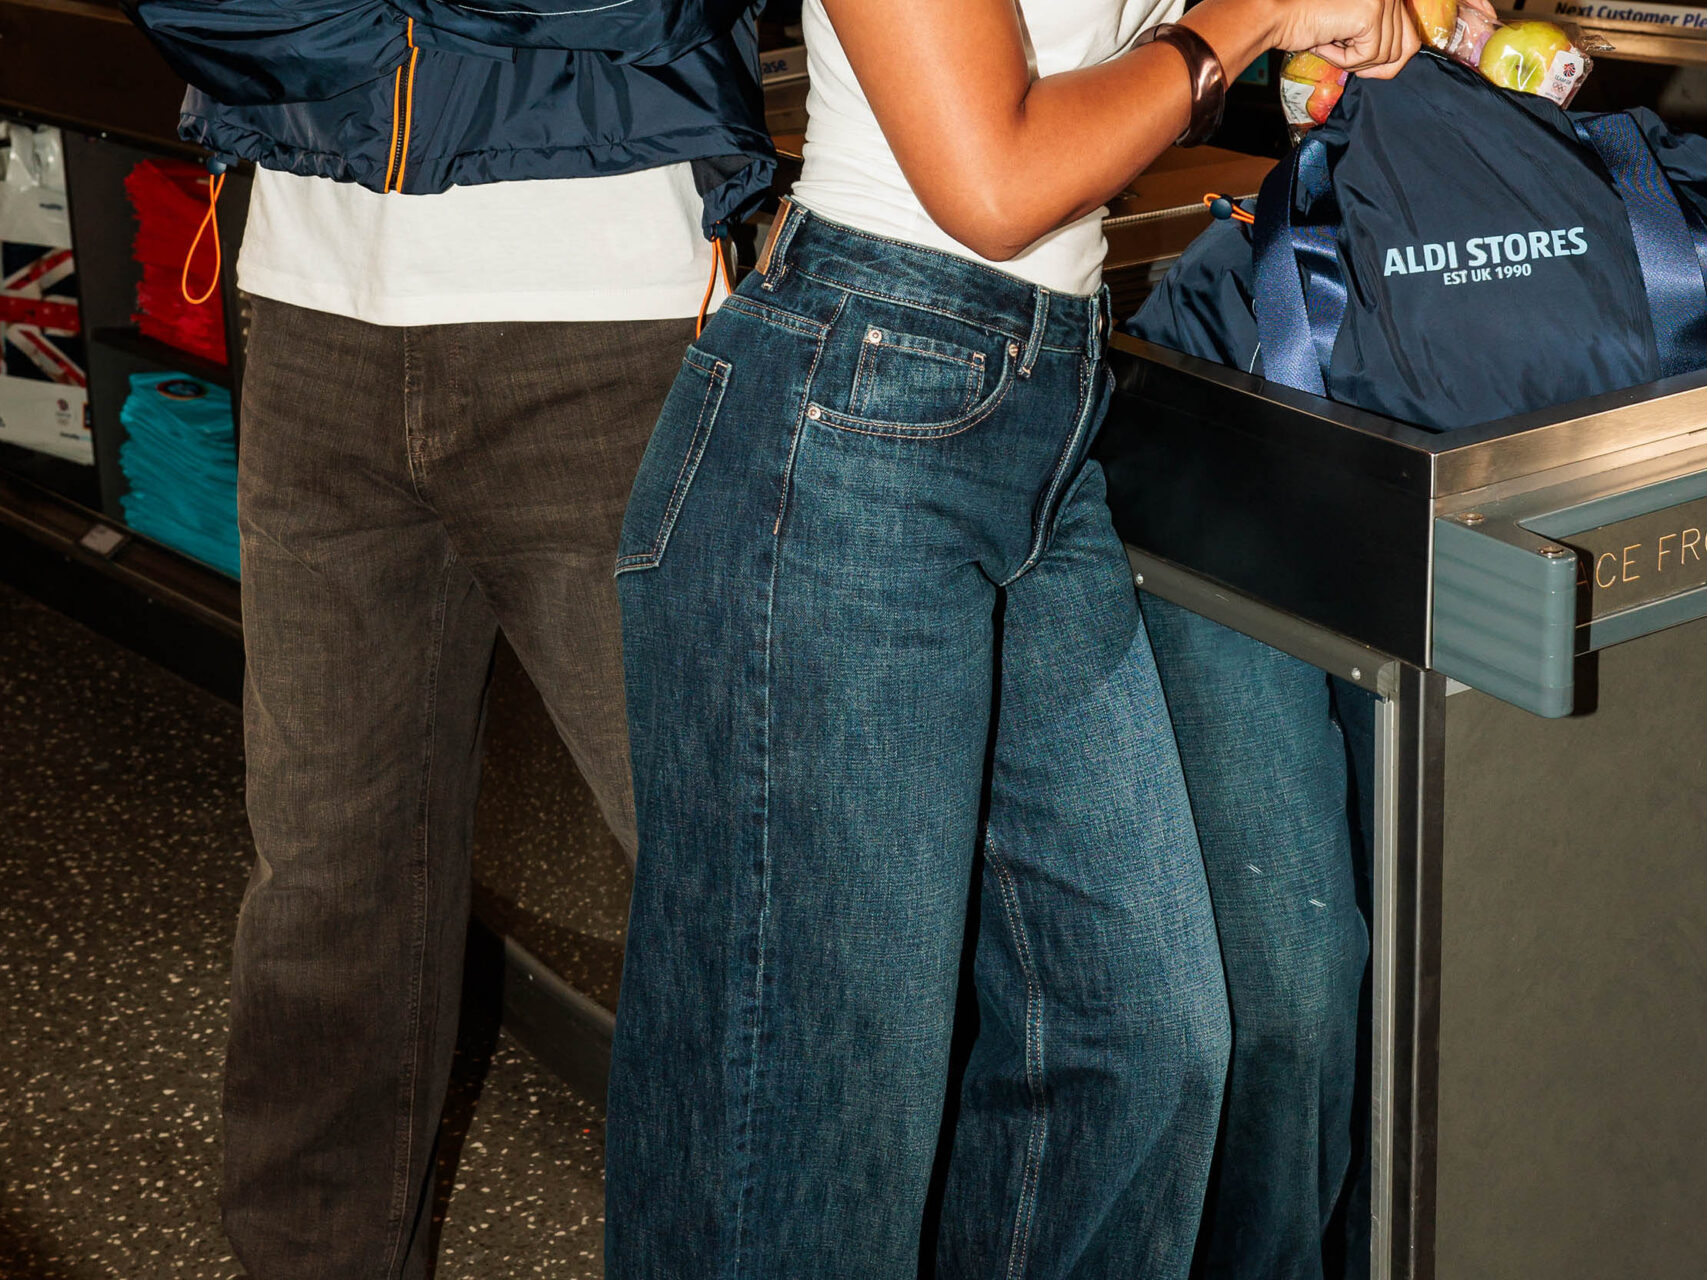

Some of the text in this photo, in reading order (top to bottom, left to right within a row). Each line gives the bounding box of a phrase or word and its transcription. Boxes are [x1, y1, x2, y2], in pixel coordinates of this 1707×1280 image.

[1554, 1, 1594, 16] Next
[1597, 5, 1679, 25] Customer
[1383, 226, 1589, 277] ALDI STORES
[1443, 263, 1532, 286] EST UK 1990
[1657, 528, 1707, 572] FR
